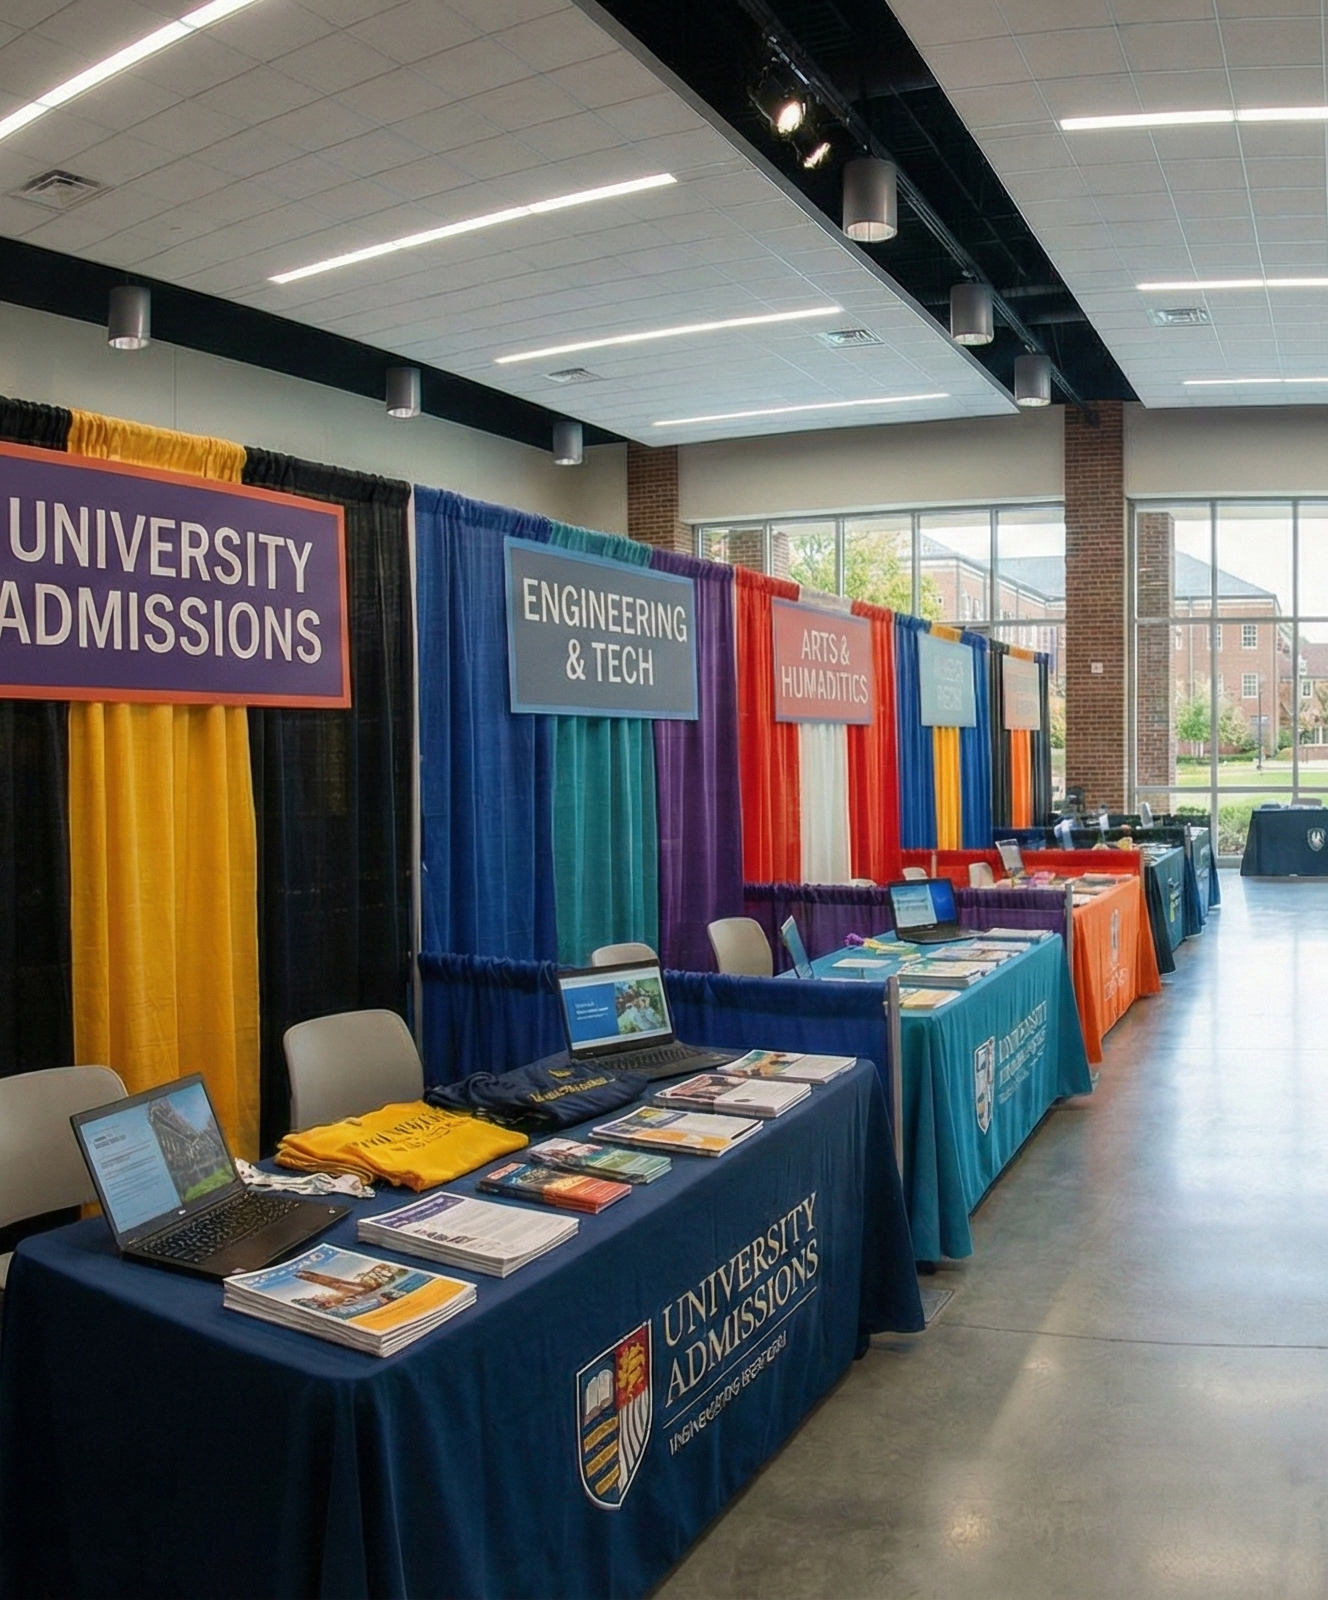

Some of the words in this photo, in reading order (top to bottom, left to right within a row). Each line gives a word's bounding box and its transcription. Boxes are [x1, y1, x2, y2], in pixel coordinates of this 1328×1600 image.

[9, 497, 313, 593] UNIVERSITY
[0, 579, 322, 664] ADMISSIONS
[523, 577, 687, 643] ENGINEERING
[801, 628, 838, 665] ARTS
[840, 635, 850, 666] &
[566, 638, 586, 681] &
[591, 641, 653, 686] TECH
[662, 1191, 817, 1347] UNIVERSITY
[664, 1238, 819, 1408] ADMISSIONS
